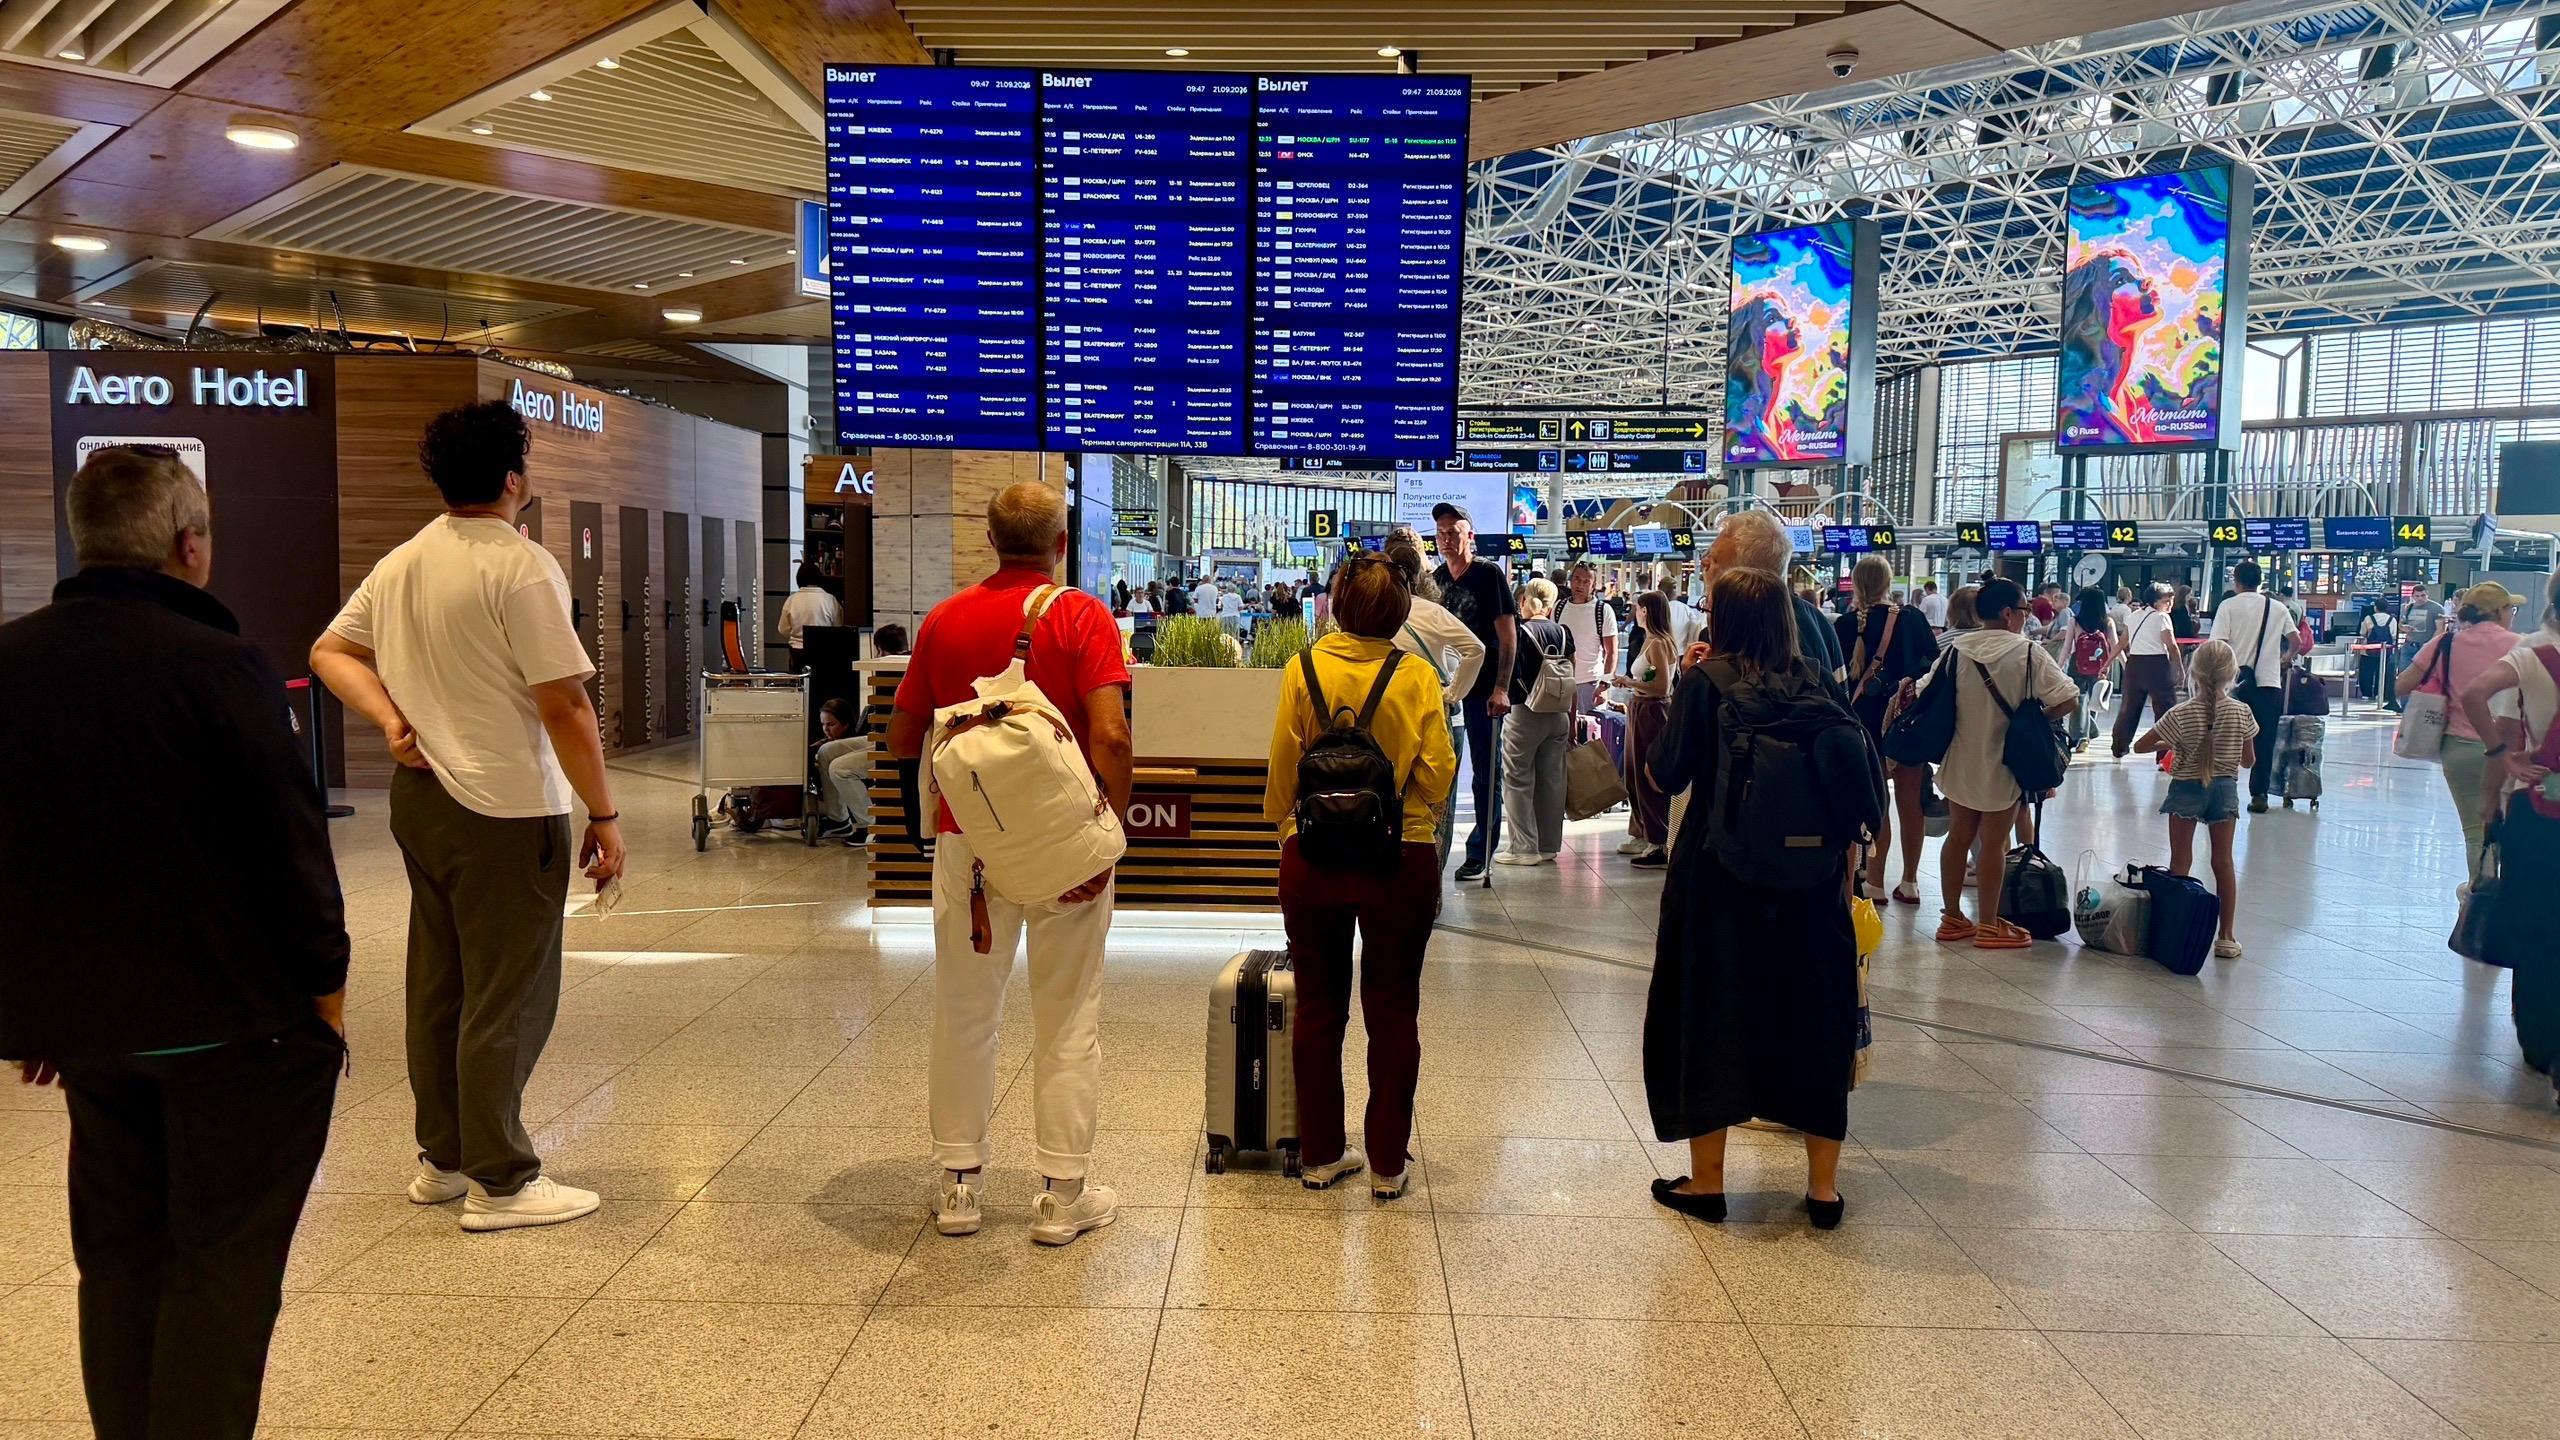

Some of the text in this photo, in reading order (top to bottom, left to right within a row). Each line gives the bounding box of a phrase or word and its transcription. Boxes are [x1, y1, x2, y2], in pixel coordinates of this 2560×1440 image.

[827, 68, 877, 83] Вылет
[1042, 73, 1093, 88] Вылет
[1258, 77, 1309, 92] Вылет
[68, 366, 307, 407] Aero Hotel
[512, 378, 604, 433] Aero Hotel
[2079, 427, 2099, 435] Russ
[2155, 422, 2206, 431] по-RUSSки
[841, 431, 954, 442] Справочная 8-800-301-19-91
[1080, 438, 1115, 447] Терминал
[1116, 440, 1179, 448] саморегистрации
[1254, 442, 1366, 452] Справочная 8-800-301-19-91
[834, 463, 874, 494] Ae
[1403, 493, 1441, 501] Получите
[1315, 514, 1330, 536] B
[1873, 532, 1892, 544] 40
[1960, 529, 1982, 542] 41
[2112, 527, 2134, 541] 42
[2212, 527, 2238, 541] 43
[2398, 524, 2426, 540] 44
[1424, 541, 1435, 551] 35
[1508, 539, 1524, 549] 36
[1569, 537, 1584, 548] 37
[1674, 534, 1691, 546] 38
[1346, 542, 1359, 552] 34
[657, 705, 664, 738] 4
[613, 710, 622, 748] 3
[1126, 804, 1176, 827] ON
